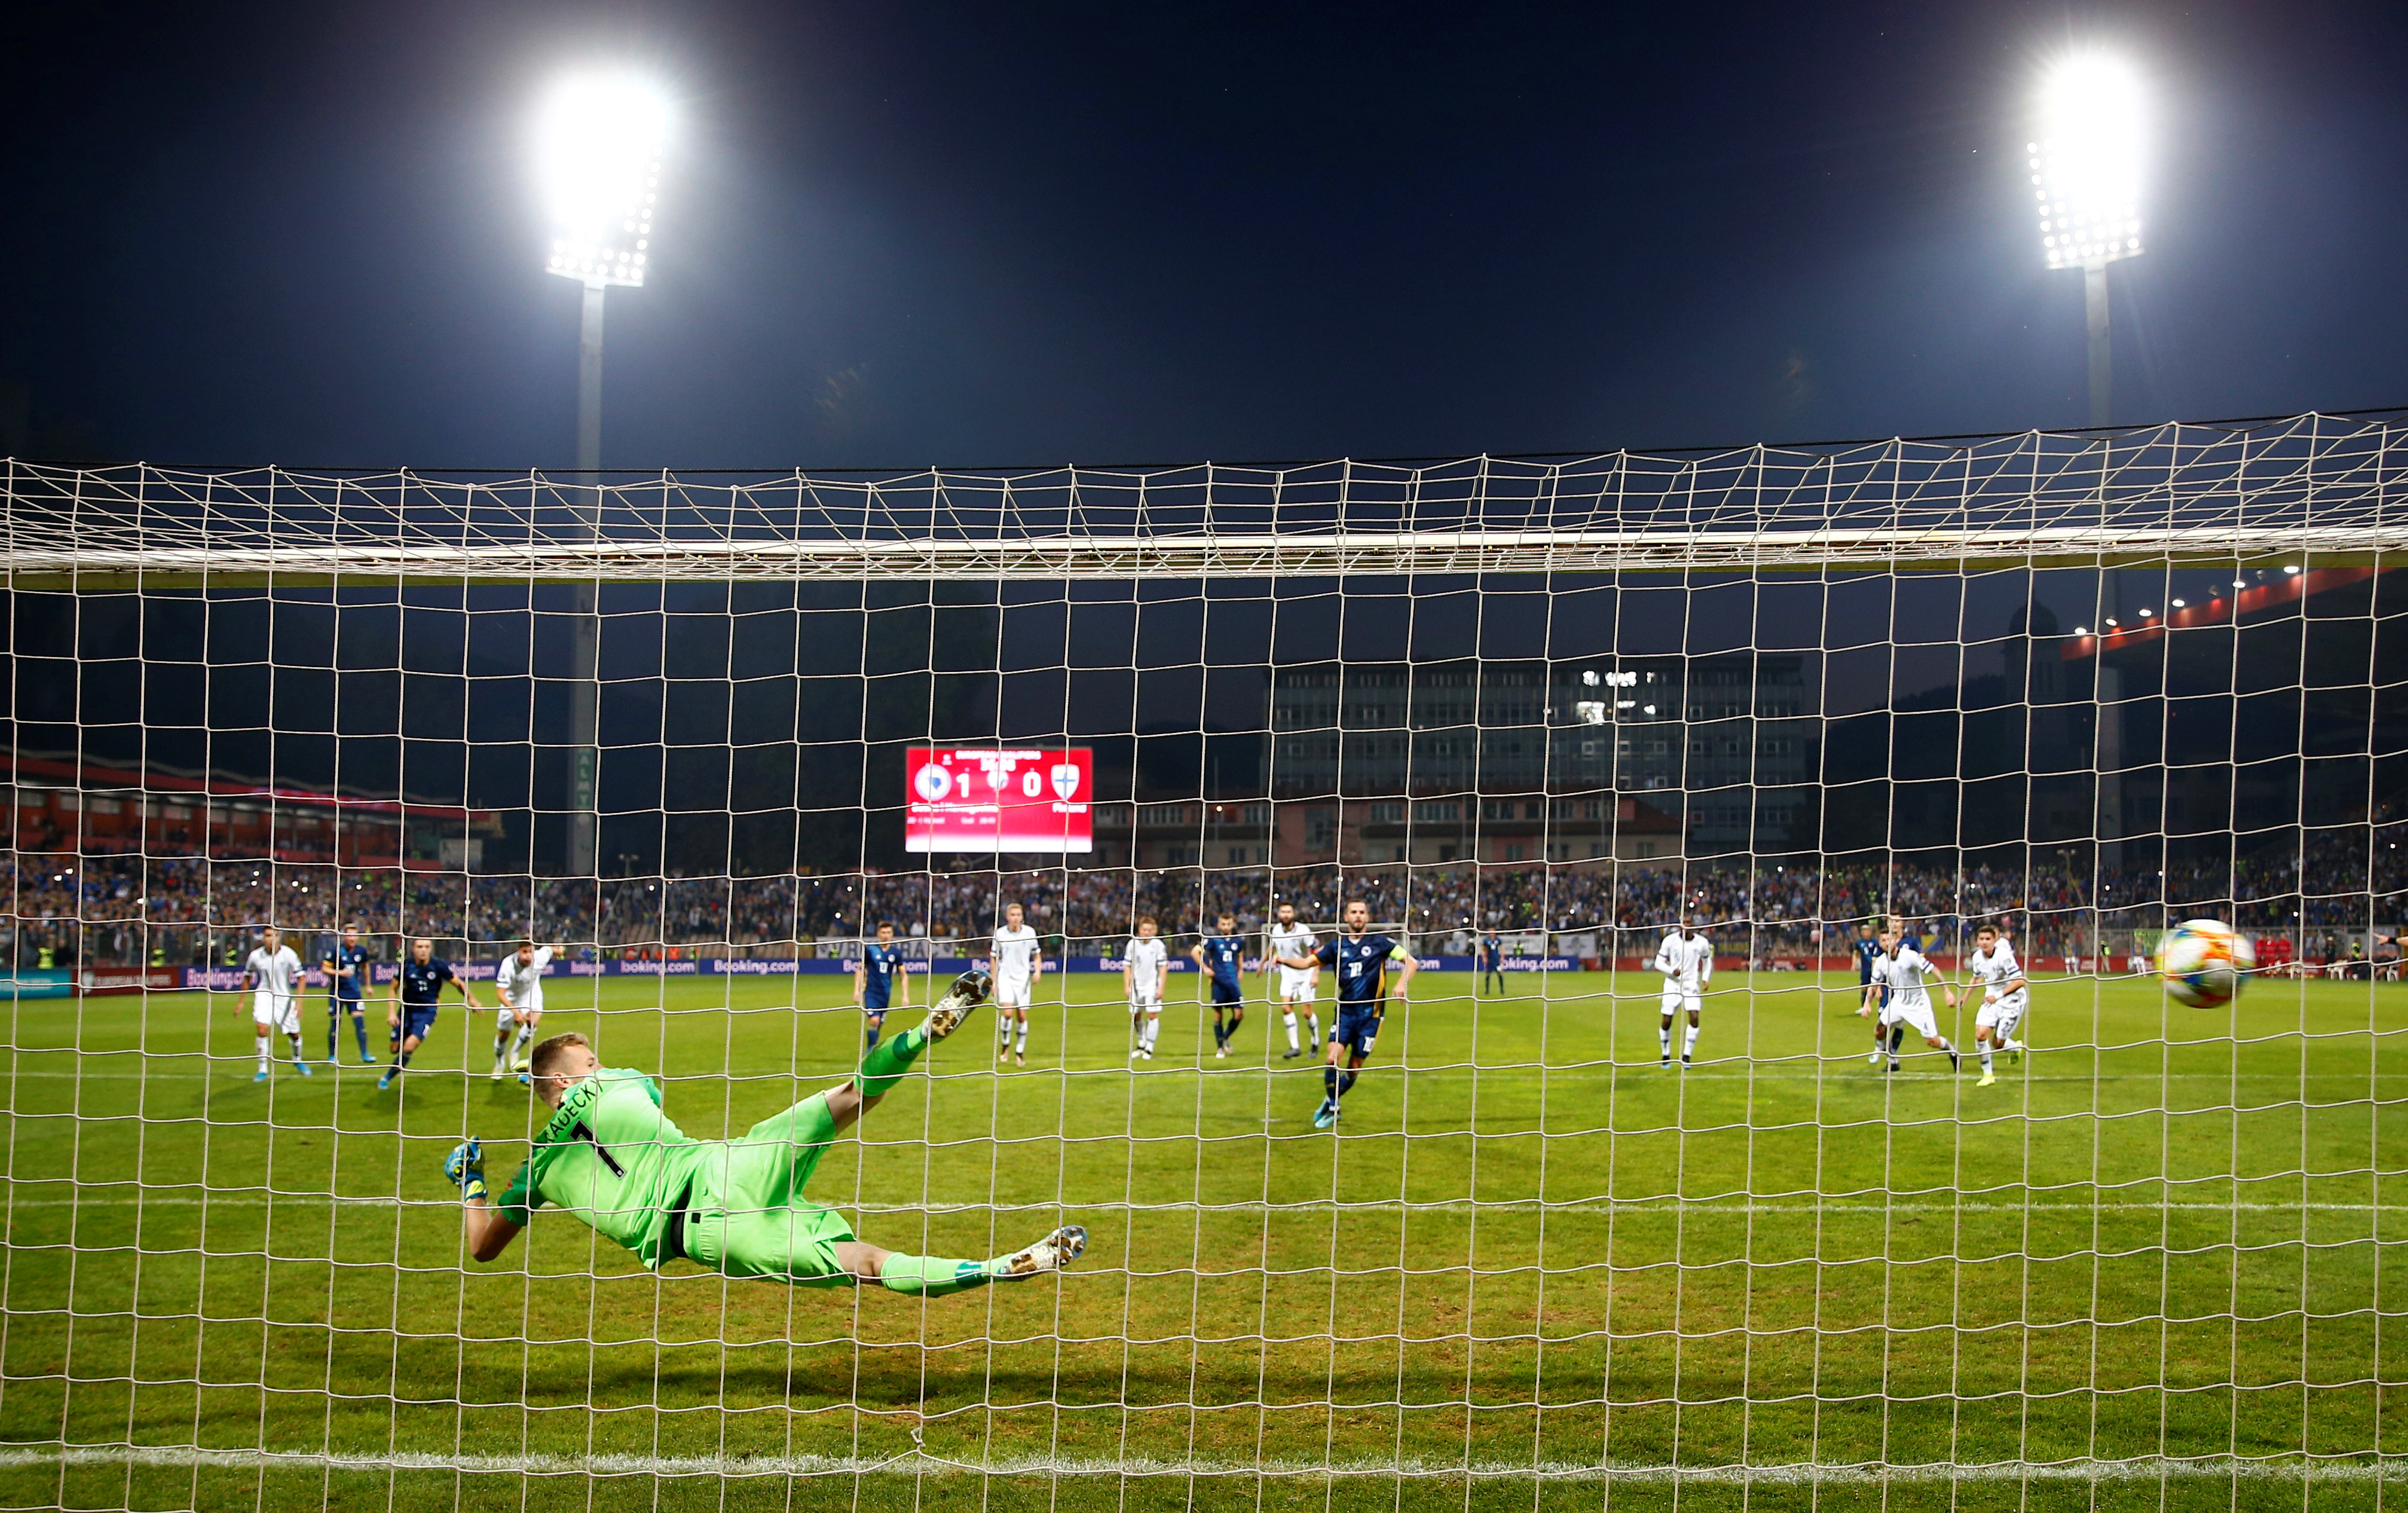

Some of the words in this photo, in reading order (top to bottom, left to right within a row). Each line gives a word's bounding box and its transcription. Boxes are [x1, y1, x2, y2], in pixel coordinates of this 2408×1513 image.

[956, 773, 969, 797] 1
[1023, 771, 1041, 797] 0
[714, 959, 800, 975] Booking.com
[570, 1118, 626, 1180] 1
